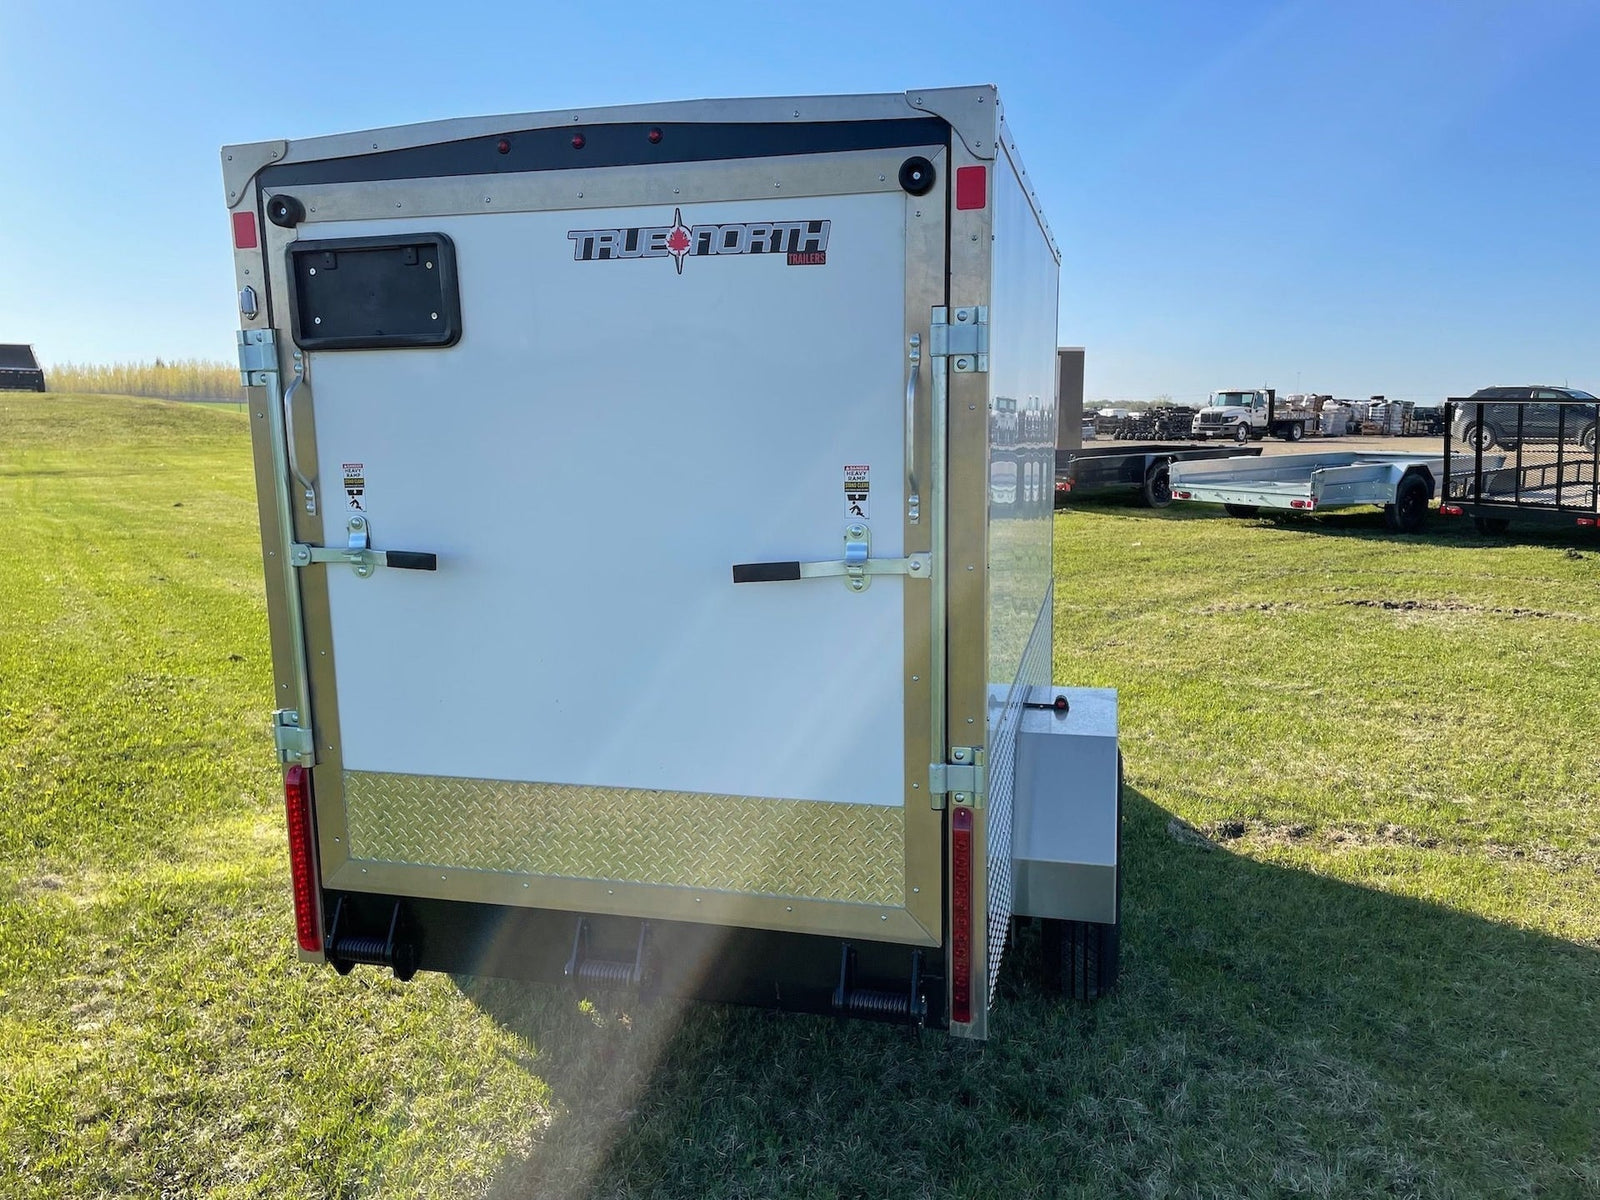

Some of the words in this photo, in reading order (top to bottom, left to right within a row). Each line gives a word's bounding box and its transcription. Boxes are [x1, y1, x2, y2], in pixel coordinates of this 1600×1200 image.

[568, 227, 671, 260] TRUE
[688, 220, 831, 256] NORTH
[787, 252, 826, 265] TRAILERS
